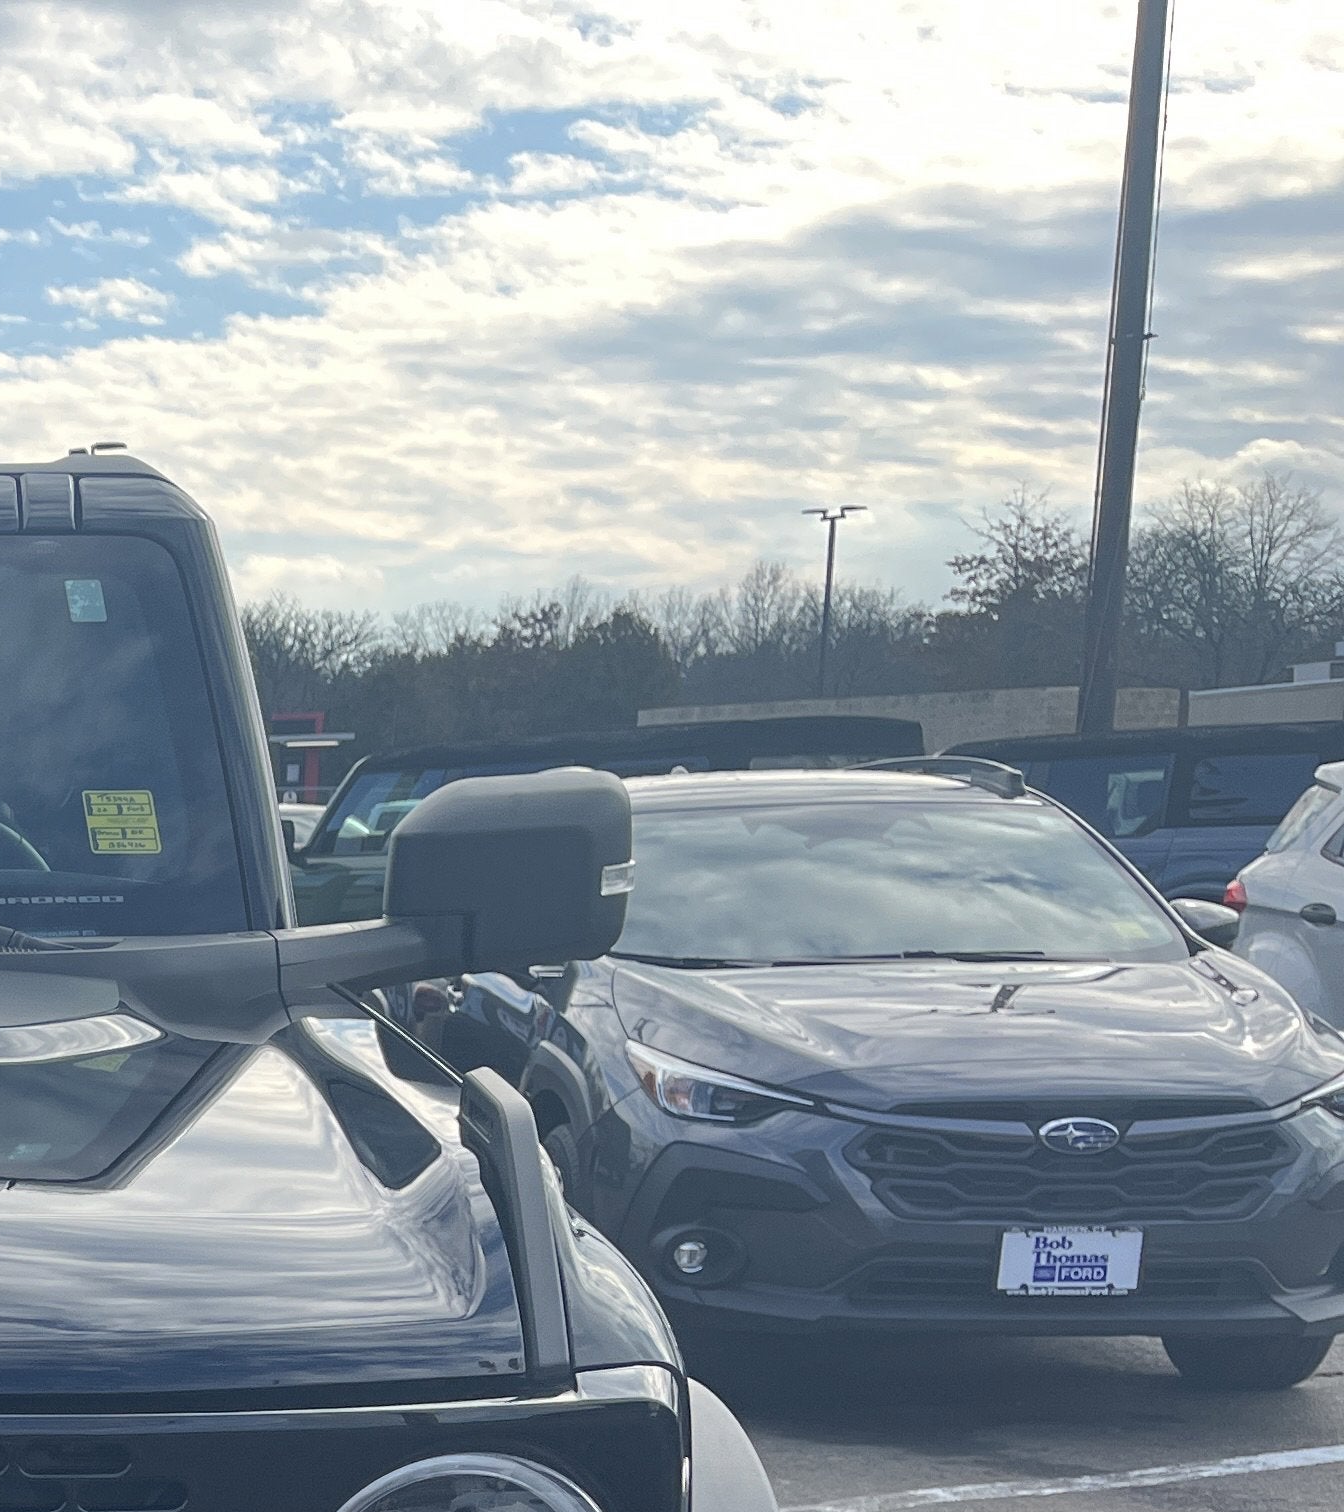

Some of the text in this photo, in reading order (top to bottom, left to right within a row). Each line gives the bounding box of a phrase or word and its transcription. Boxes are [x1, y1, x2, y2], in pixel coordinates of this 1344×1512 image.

[1034, 1236, 1072, 1249] Bob
[1033, 1250, 1109, 1264] Thomas
[1060, 1267, 1105, 1280] FORD
